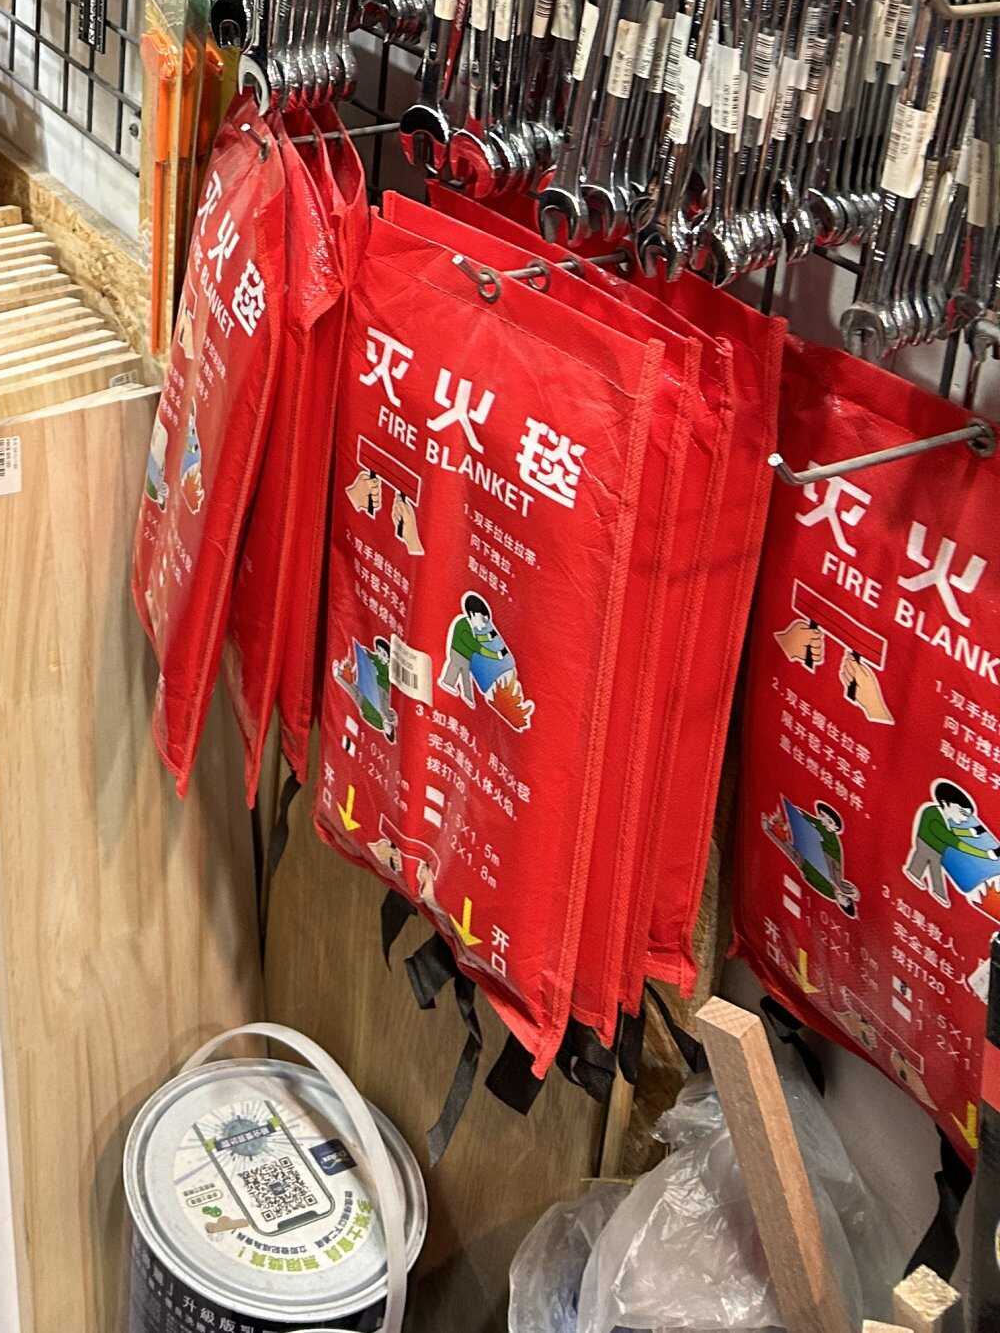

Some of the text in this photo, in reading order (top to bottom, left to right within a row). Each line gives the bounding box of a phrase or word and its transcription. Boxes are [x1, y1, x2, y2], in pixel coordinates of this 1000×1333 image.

[359, 326, 588, 509] 灭火毯
[377, 405, 535, 517] FIRE BLANKET
[820, 551, 883, 610] FIRE
[491, 924, 510, 978] 开口
